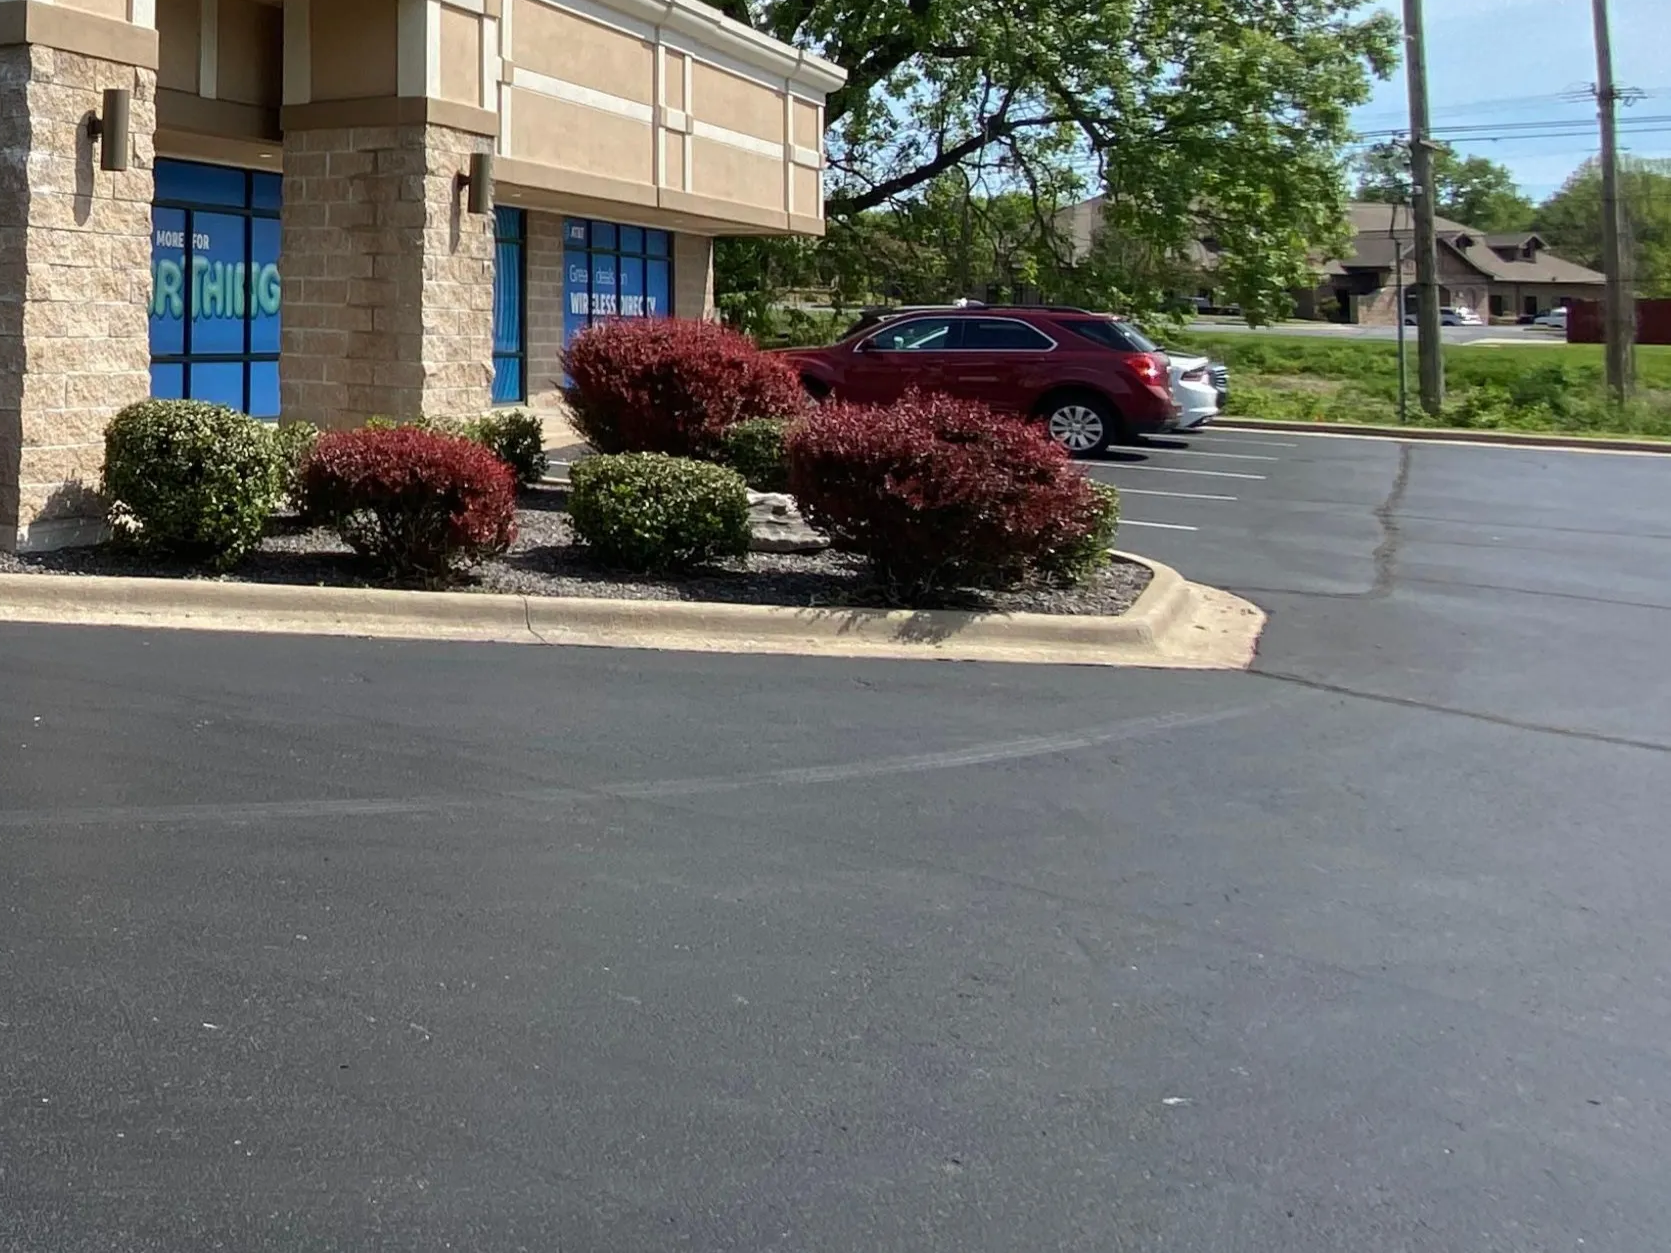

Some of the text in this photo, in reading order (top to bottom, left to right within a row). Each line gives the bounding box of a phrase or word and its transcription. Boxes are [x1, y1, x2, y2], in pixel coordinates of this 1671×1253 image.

[156, 230, 210, 250] MORE FOR
[569, 264, 589, 283] Grea
[570, 291, 616, 315] WIRELESS
